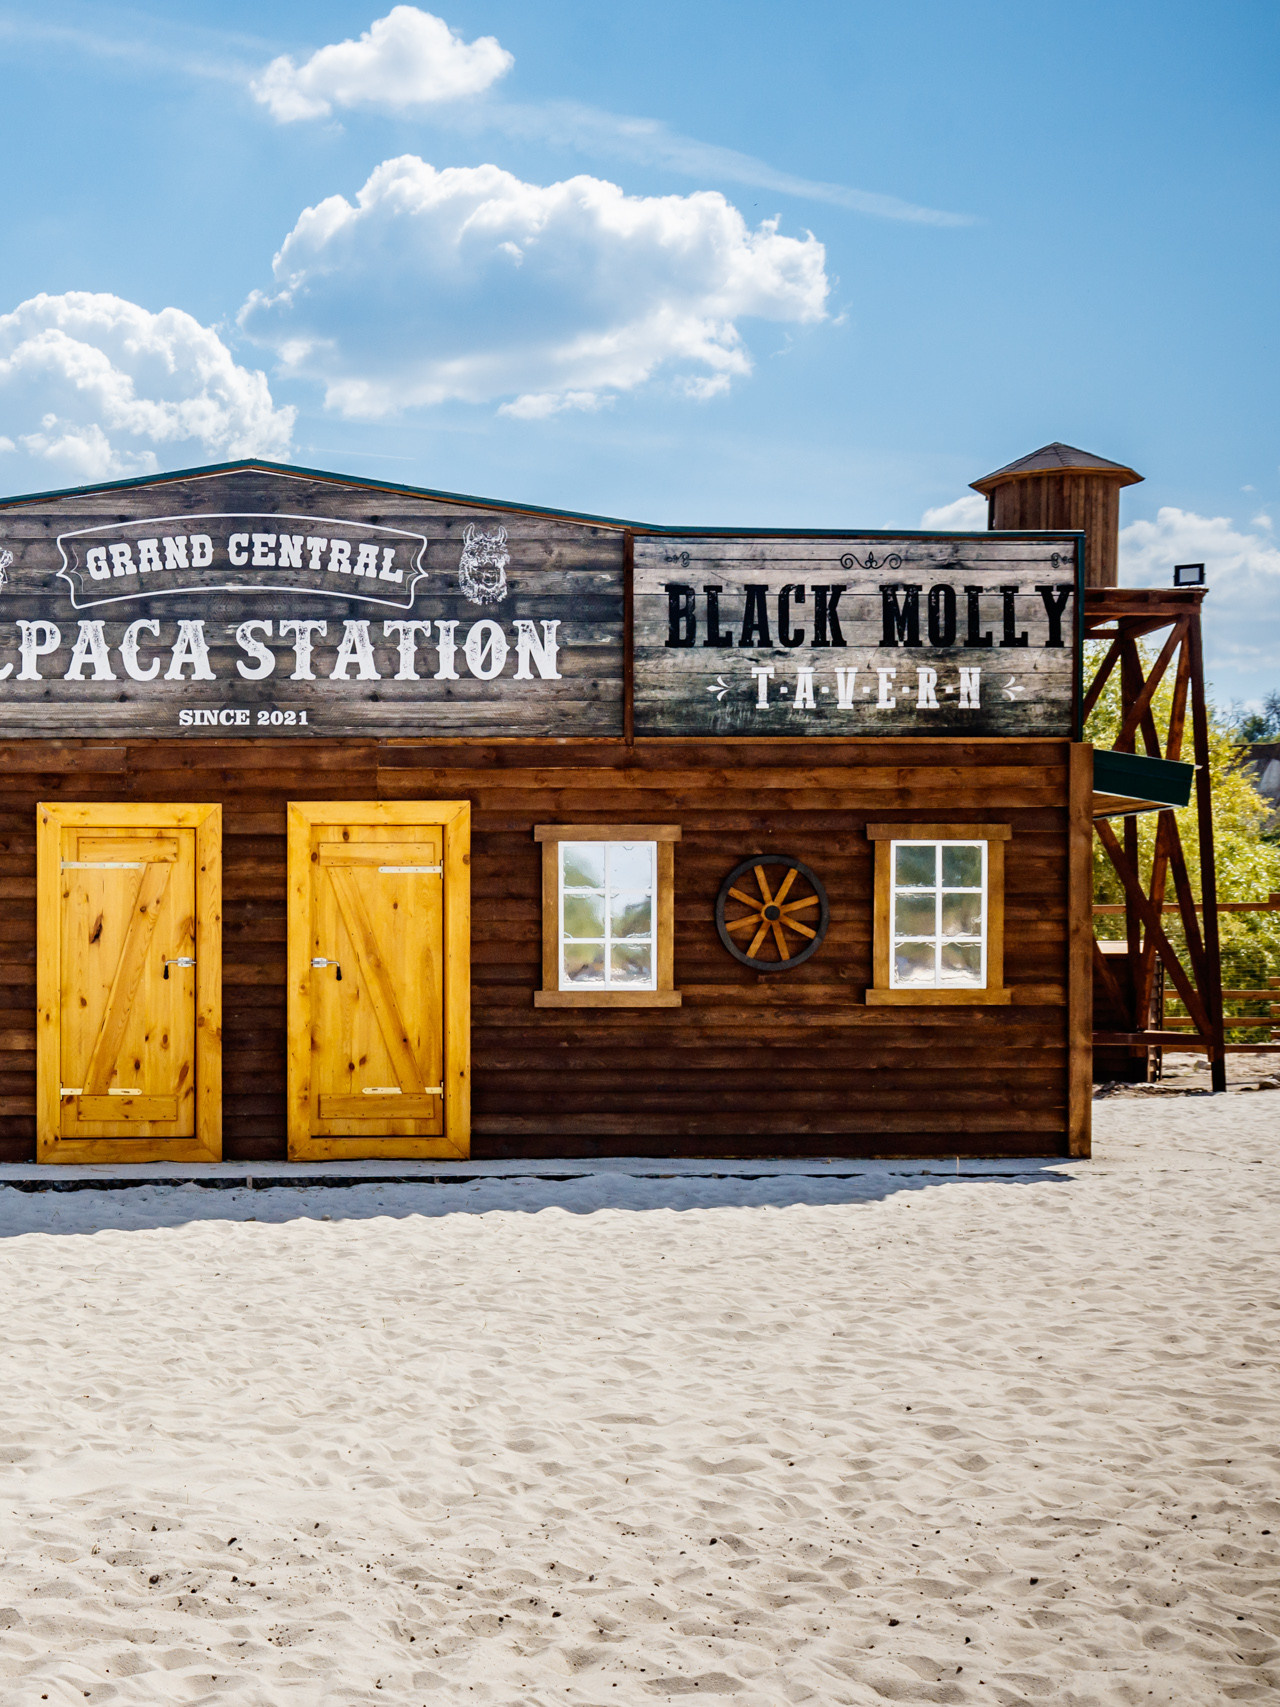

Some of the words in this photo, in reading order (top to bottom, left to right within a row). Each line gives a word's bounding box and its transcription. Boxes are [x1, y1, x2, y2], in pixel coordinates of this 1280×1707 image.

[86, 533, 215, 581] GRAND
[227, 533, 404, 583] CENTRAL
[662, 584, 848, 649] BLACK
[878, 583, 1076, 649] MOLLY
[178, 709, 251, 726] SINCE
[257, 710, 310, 726] 2021
